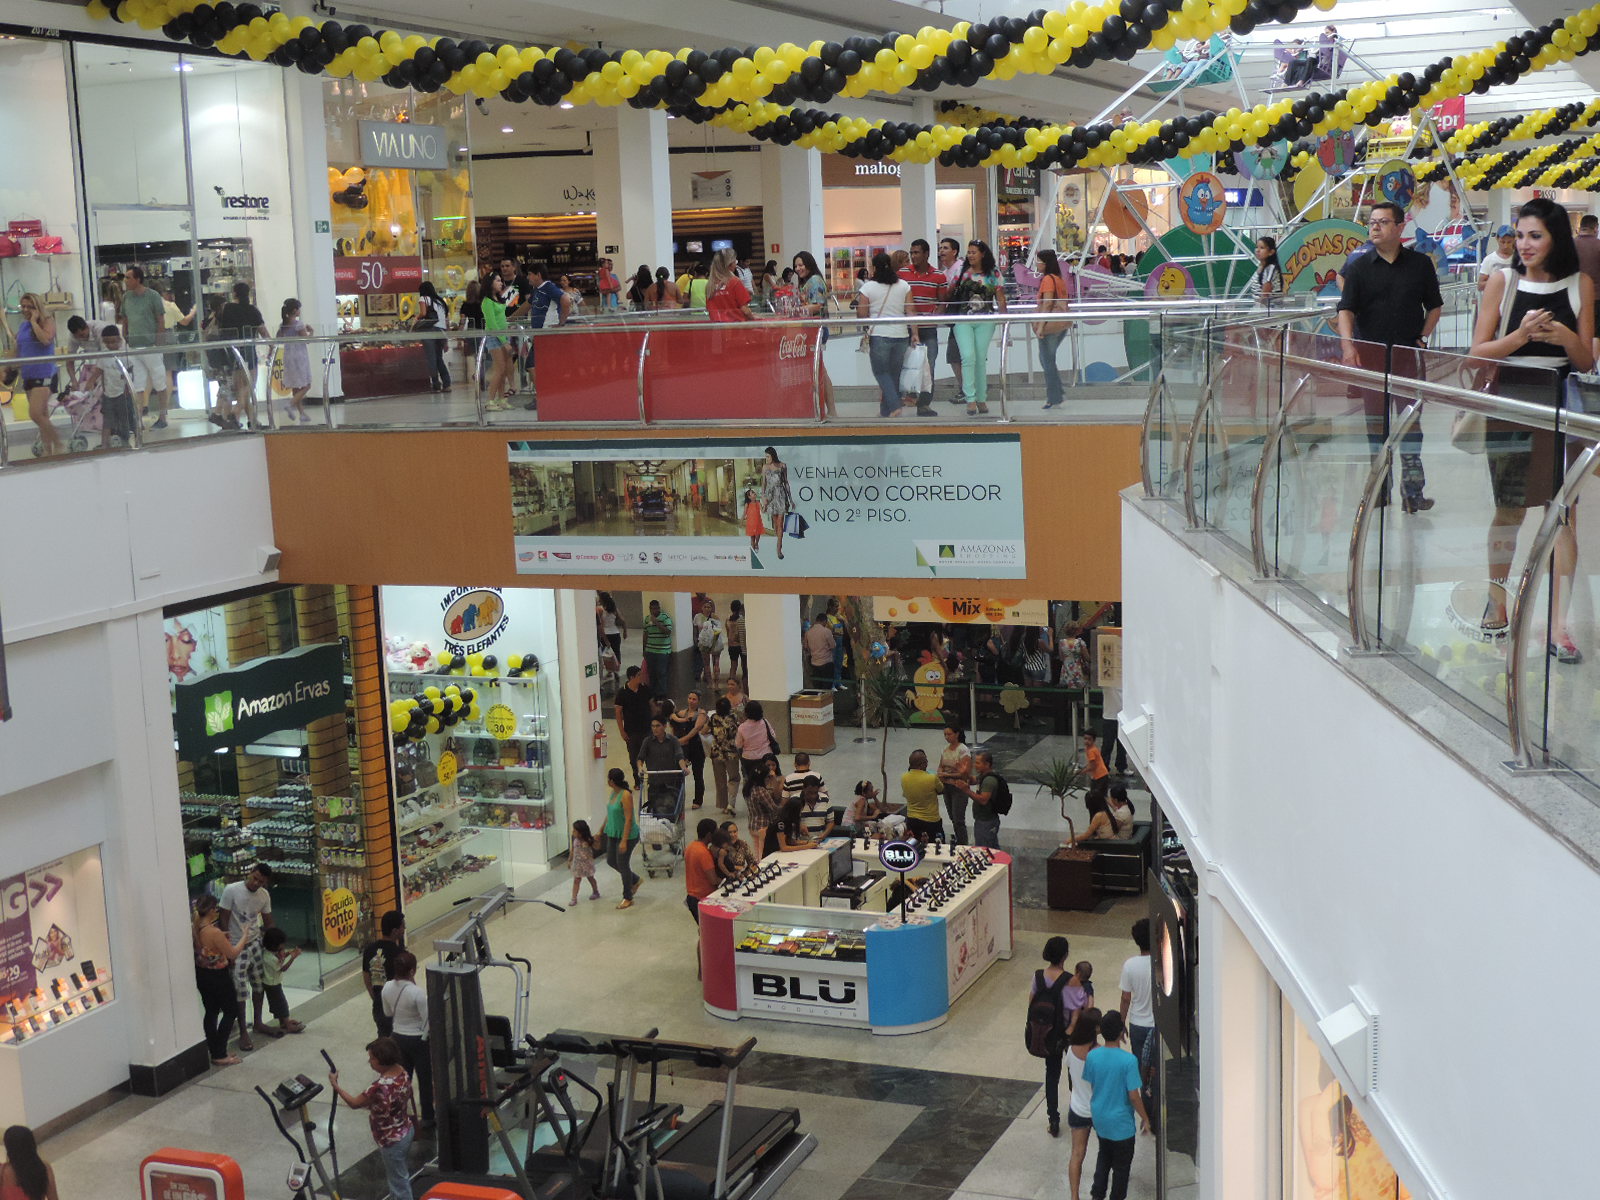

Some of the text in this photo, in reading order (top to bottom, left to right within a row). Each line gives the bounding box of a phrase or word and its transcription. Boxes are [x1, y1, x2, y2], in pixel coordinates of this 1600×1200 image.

[372, 130, 437, 160] VIA UNO
[794, 465, 942, 480] VENHA CONHECER
[798, 484, 1002, 502] O NOVO CORREDOR
[814, 508, 840, 523] NO
[867, 508, 912, 523] PISO.
[960, 544, 1017, 554] AMAZONAS
[952, 600, 982, 616] Mix
[466, 615, 510, 656] ELEFANTES
[237, 679, 332, 721] Amazon Ervas
[326, 894, 355, 916] Liquida
[324, 908, 354, 931] Ponto
[337, 921, 354, 940] Mix
